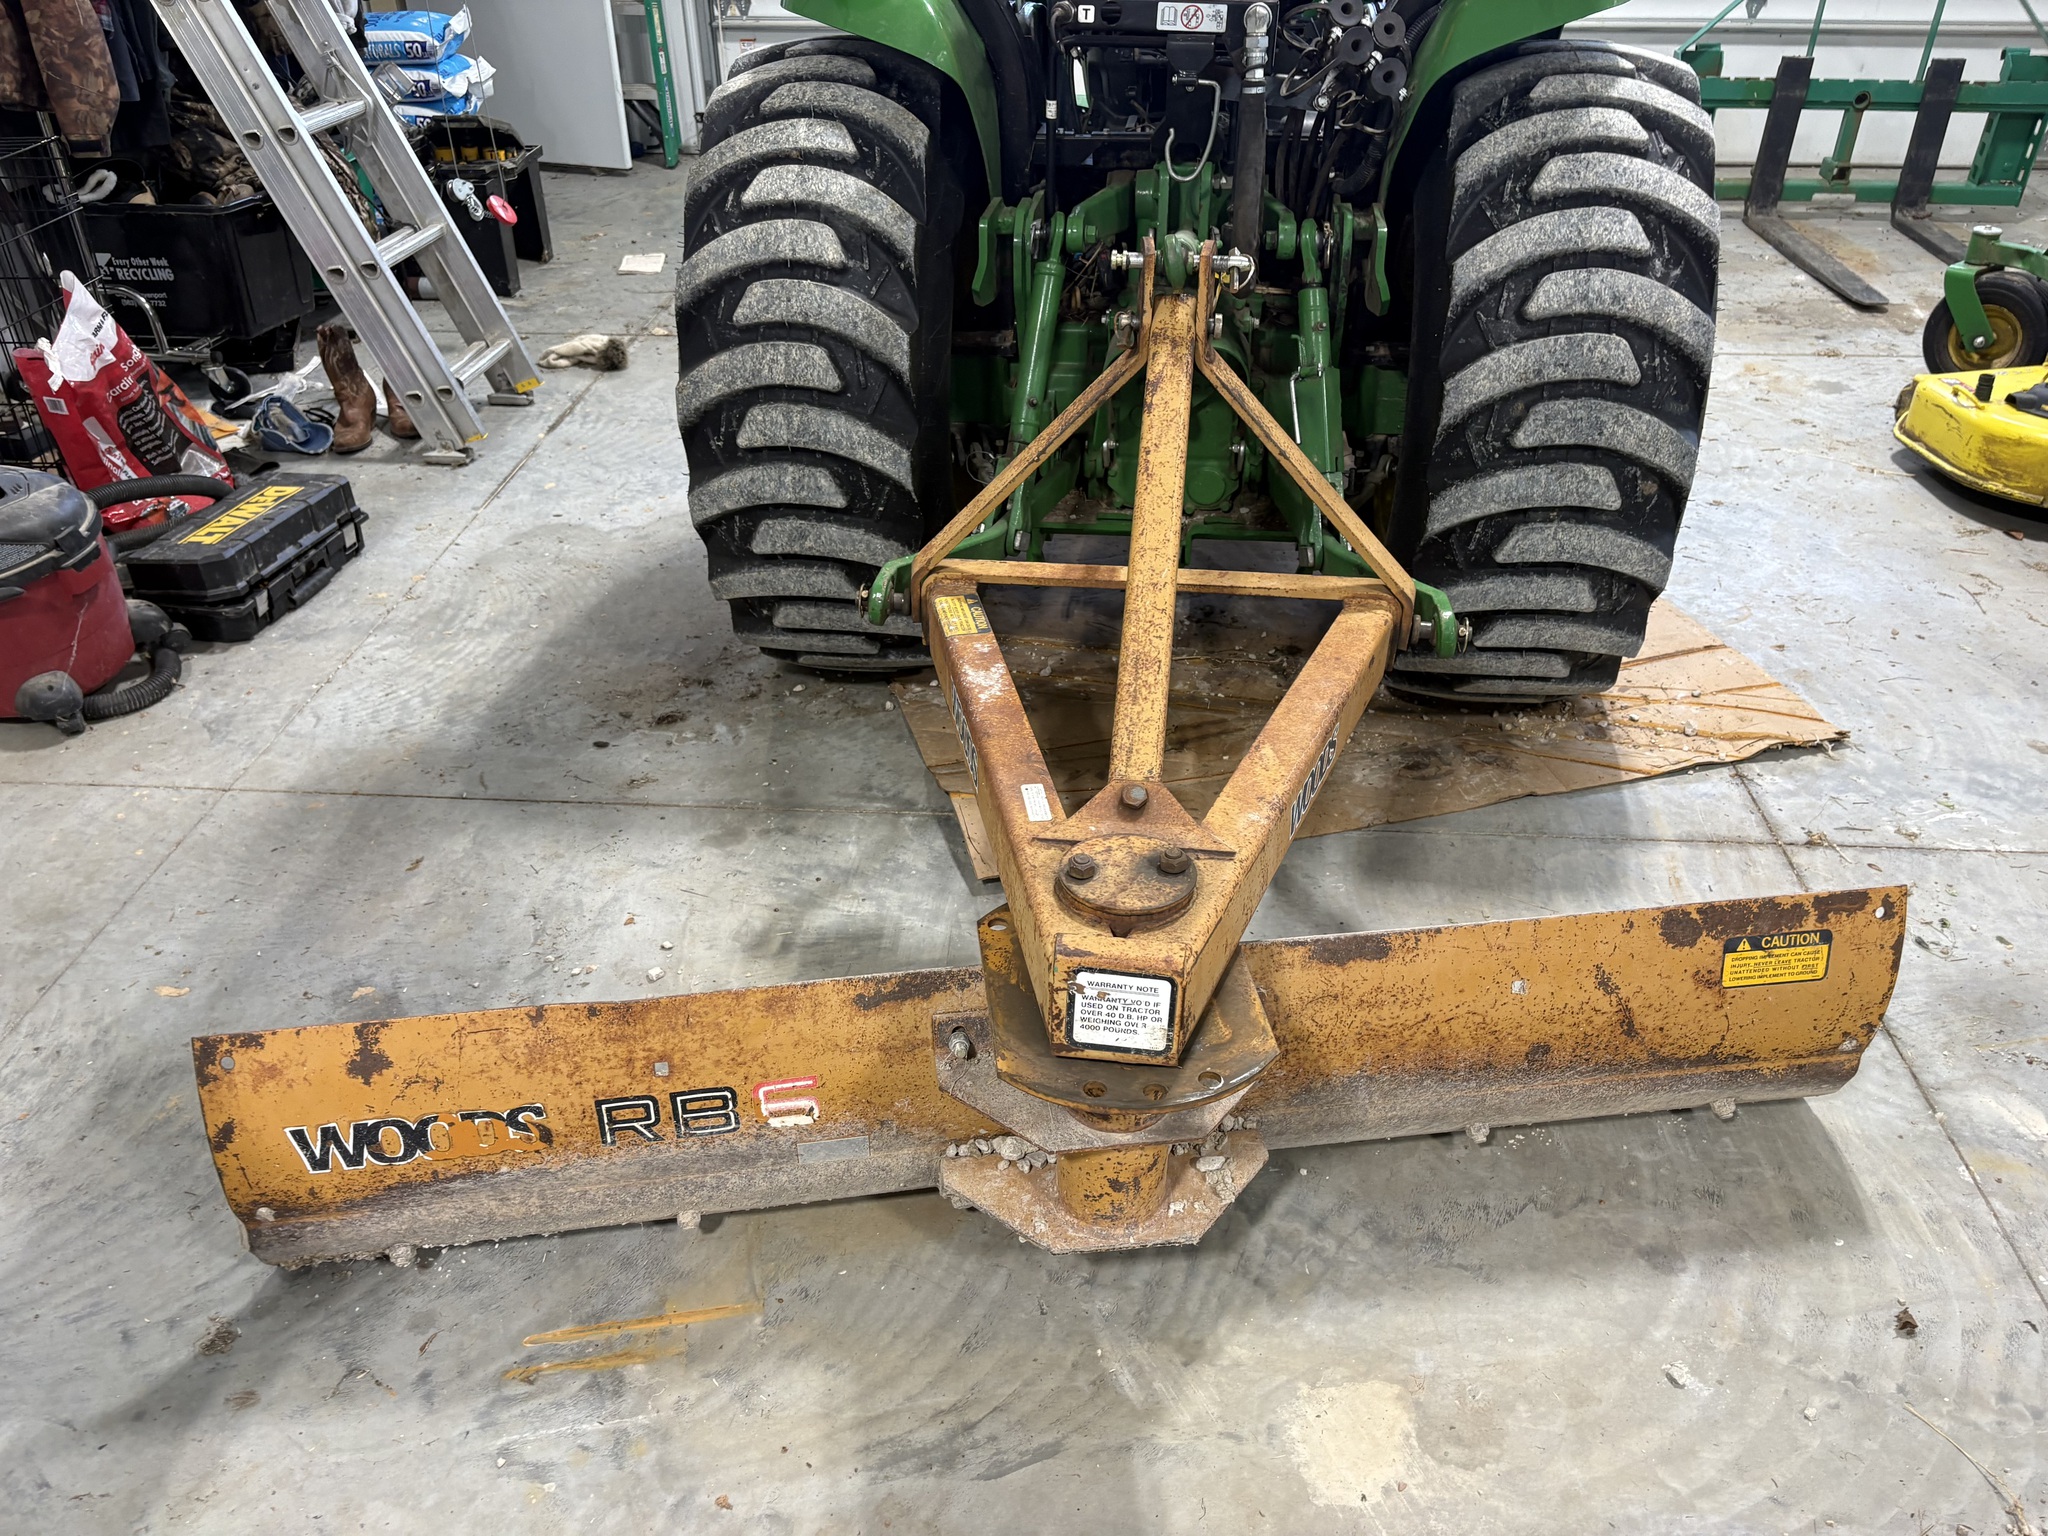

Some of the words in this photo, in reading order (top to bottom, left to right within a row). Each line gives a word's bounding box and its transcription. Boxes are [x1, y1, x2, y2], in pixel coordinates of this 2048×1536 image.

[1082, 8, 1091, 20] T
[405, 43, 422, 58] 50
[111, 257, 130, 268] Every
[130, 257, 150, 266] Other
[149, 257, 169, 267] Week
[116, 268, 174, 281] RECYCLING
[182, 486, 302, 544] DEWALT
[971, 606, 988, 629] CAUTION
[1289, 722, 1340, 840] WOODS
[1761, 932, 1820, 948] CAUTION
[1087, 980, 1133, 990] WARRANTY
[1122, 1006, 1160, 1015] TRACTOR
[1080, 1016, 1121, 1026] WEIGHING
[1103, 1026, 1140, 1035] POUNDS.
